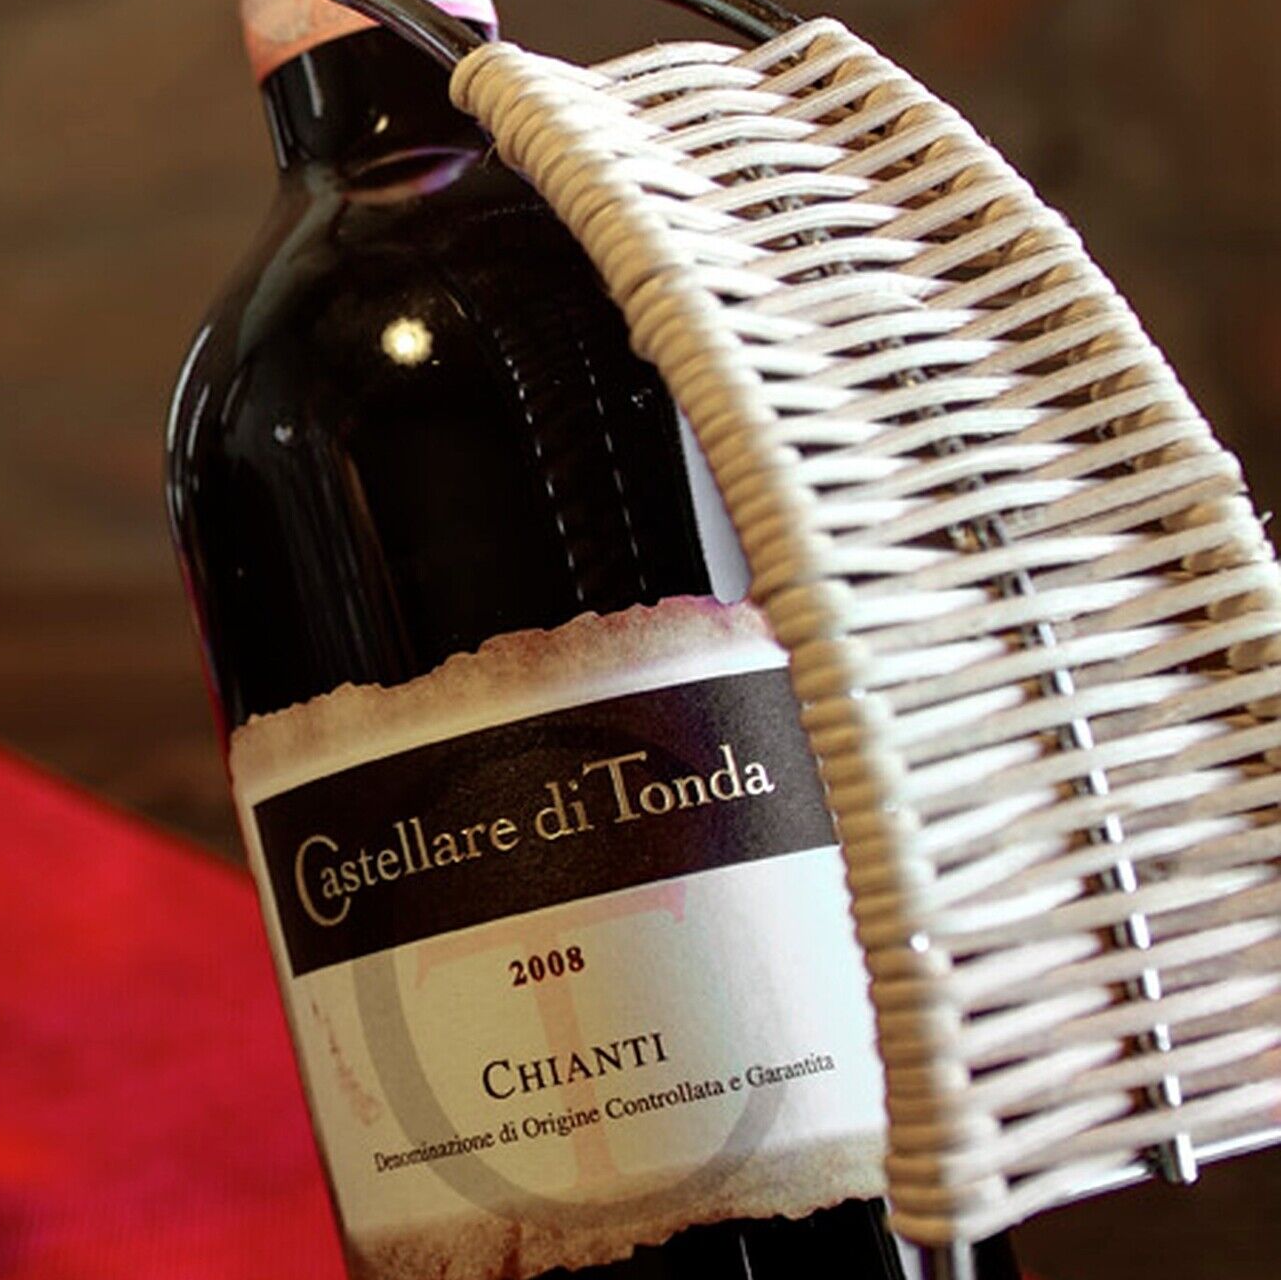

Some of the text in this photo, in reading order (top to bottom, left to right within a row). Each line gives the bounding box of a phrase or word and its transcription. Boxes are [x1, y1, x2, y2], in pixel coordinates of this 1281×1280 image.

[295, 744, 776, 927] Castellare di Tonda
[508, 946, 585, 987] 2008
[374, 1052, 836, 1173] Denominazione di Origine Controllata e Garantita
[482, 1032, 669, 1100] CHIANTI
